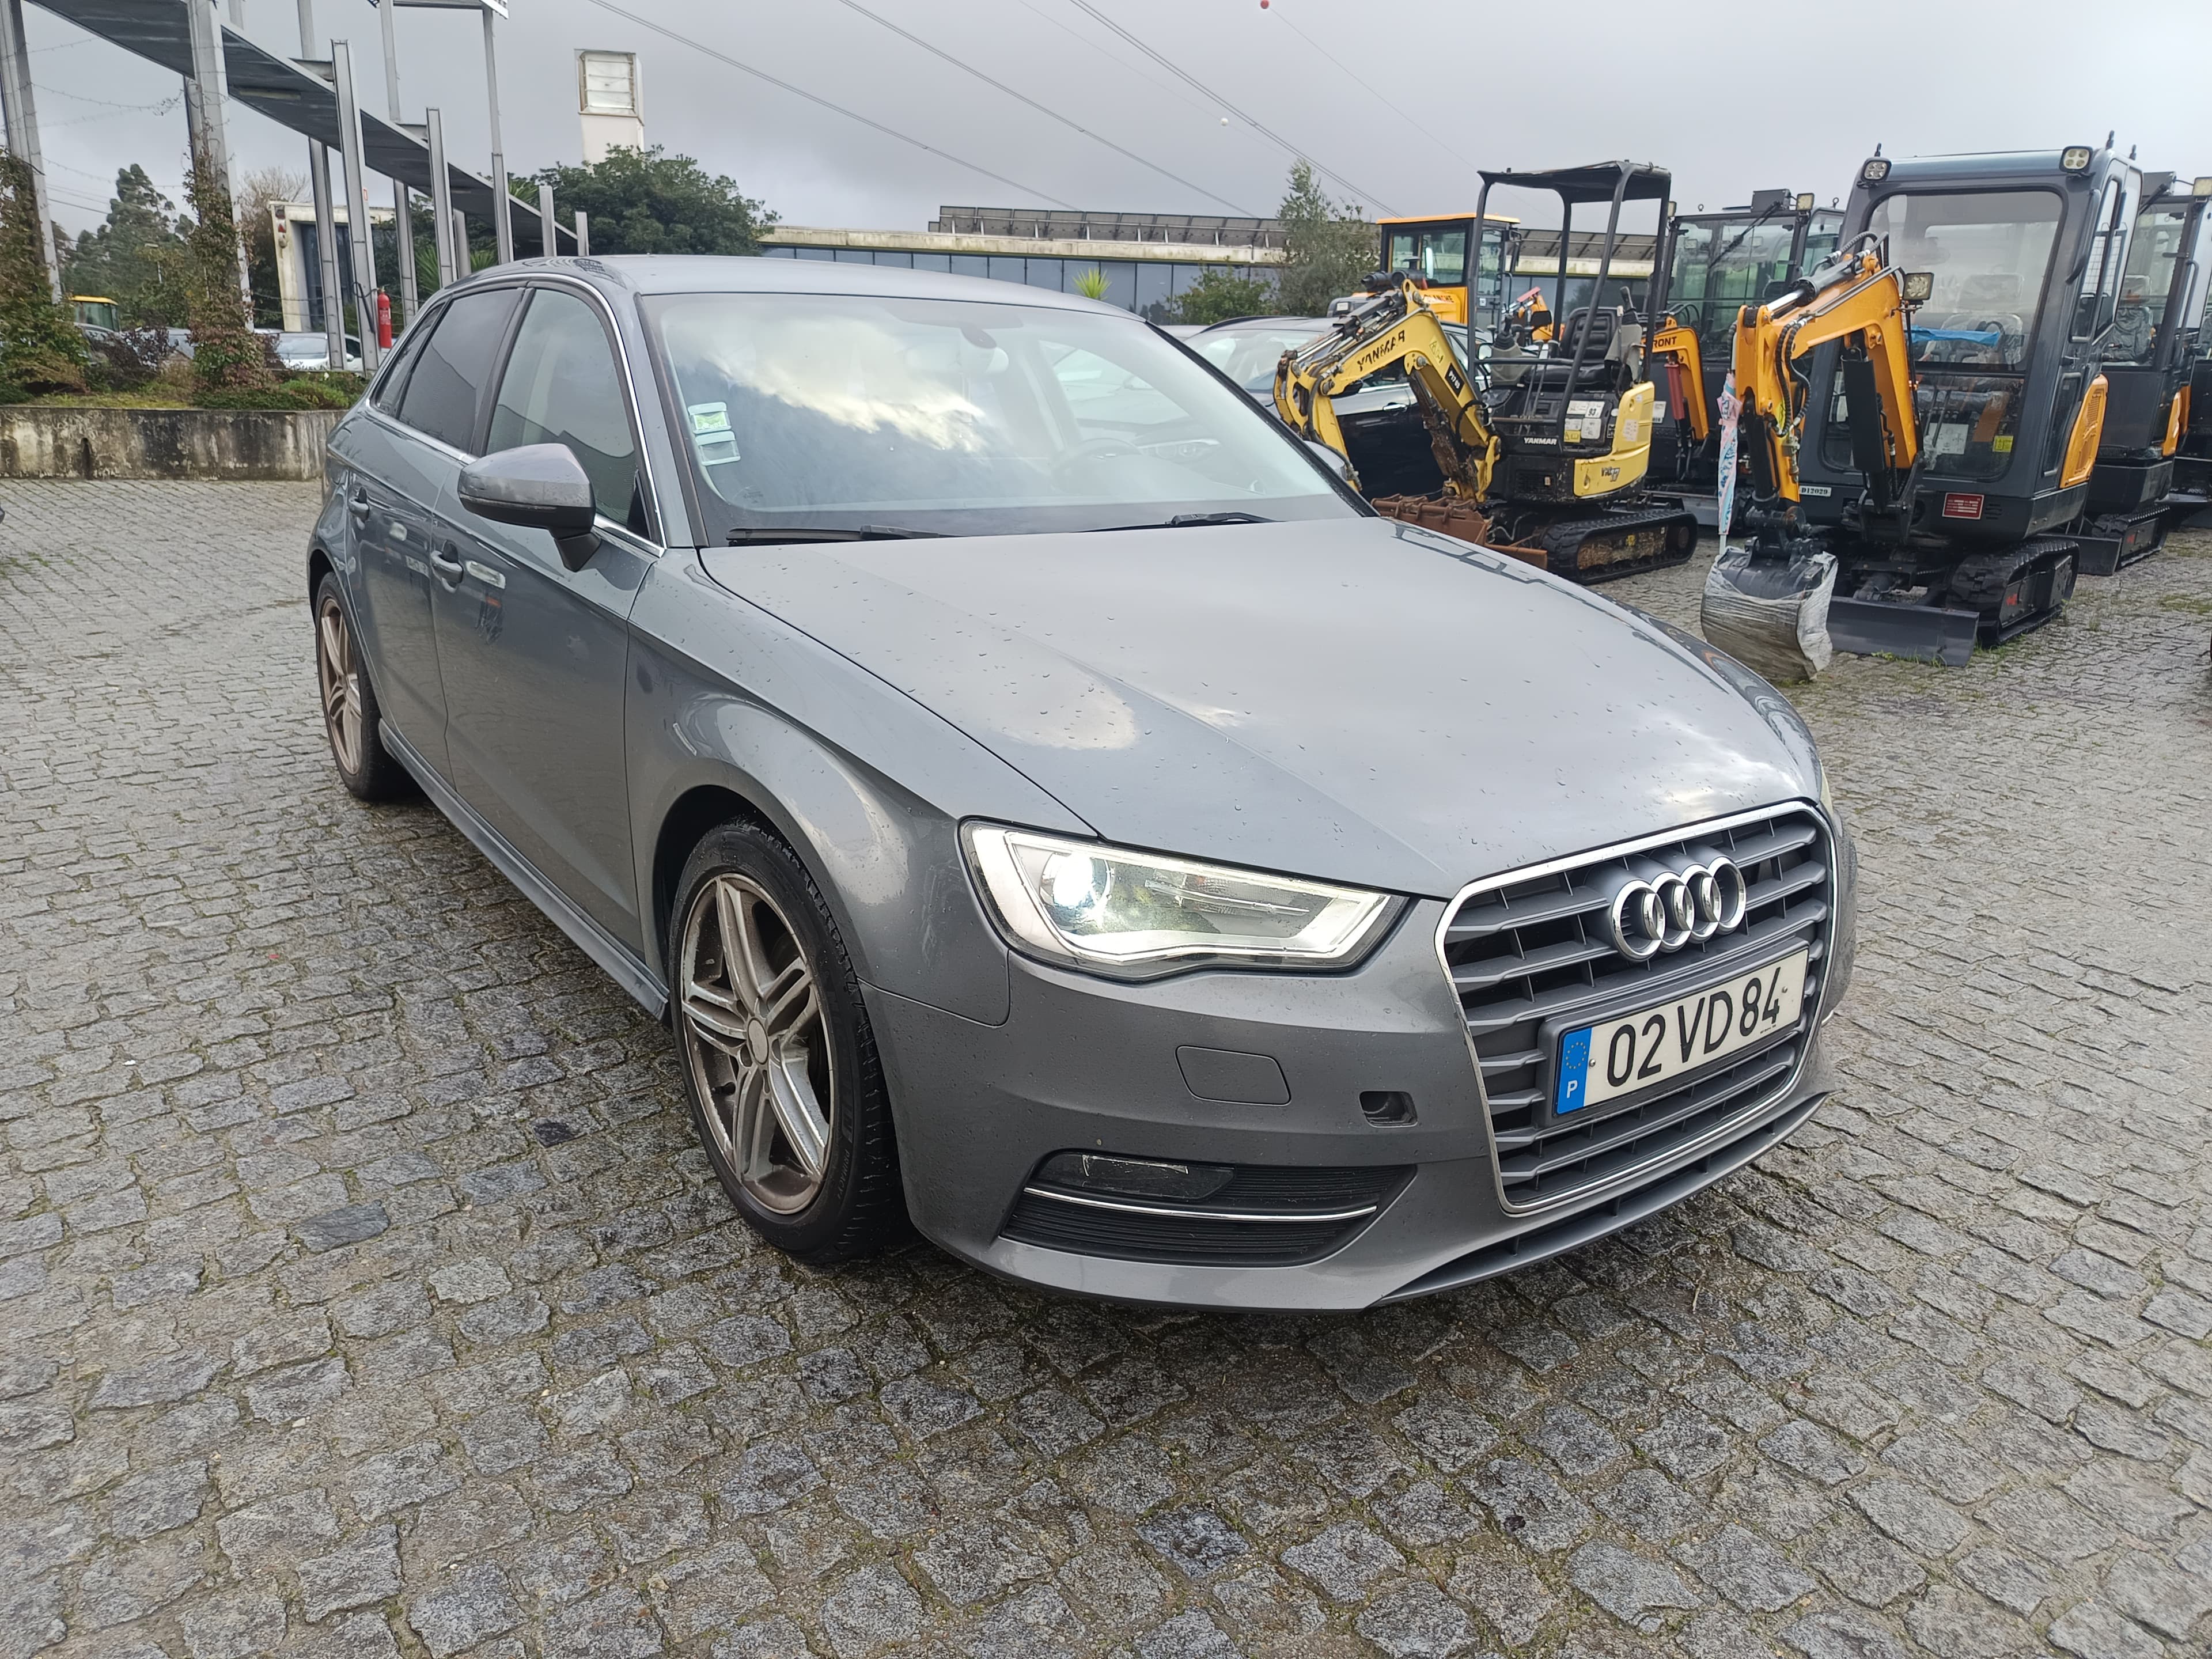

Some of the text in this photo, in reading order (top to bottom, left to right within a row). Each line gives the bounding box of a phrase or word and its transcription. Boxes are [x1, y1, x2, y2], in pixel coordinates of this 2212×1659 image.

[1357, 330, 1405, 372] YANMAR
[1653, 336, 1677, 348] RONT
[1607, 967, 1781, 1088] 02 VD 84
[1566, 1080, 1578, 1099] P
